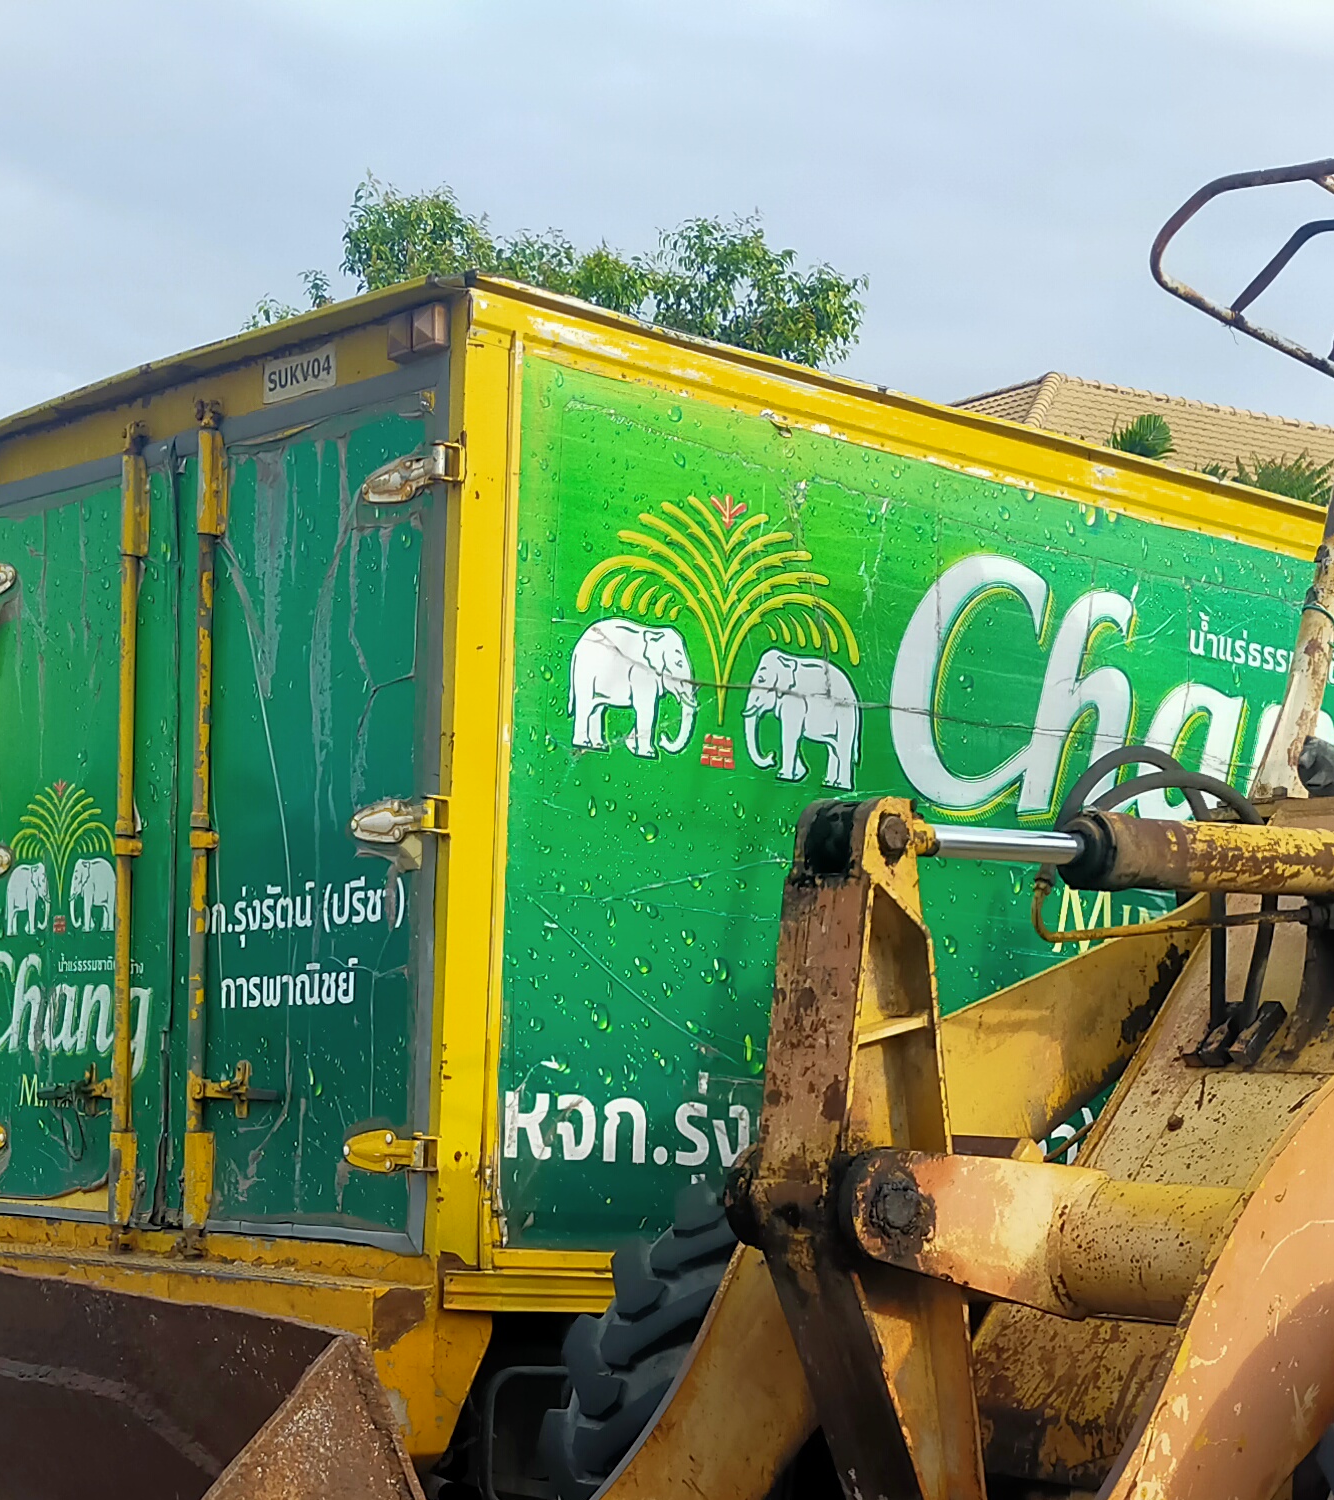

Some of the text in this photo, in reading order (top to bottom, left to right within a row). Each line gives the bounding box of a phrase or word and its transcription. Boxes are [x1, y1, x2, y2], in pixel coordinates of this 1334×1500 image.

[267, 353, 332, 393] SUKV04
[220, 957, 359, 1009] การพาณิชย์
